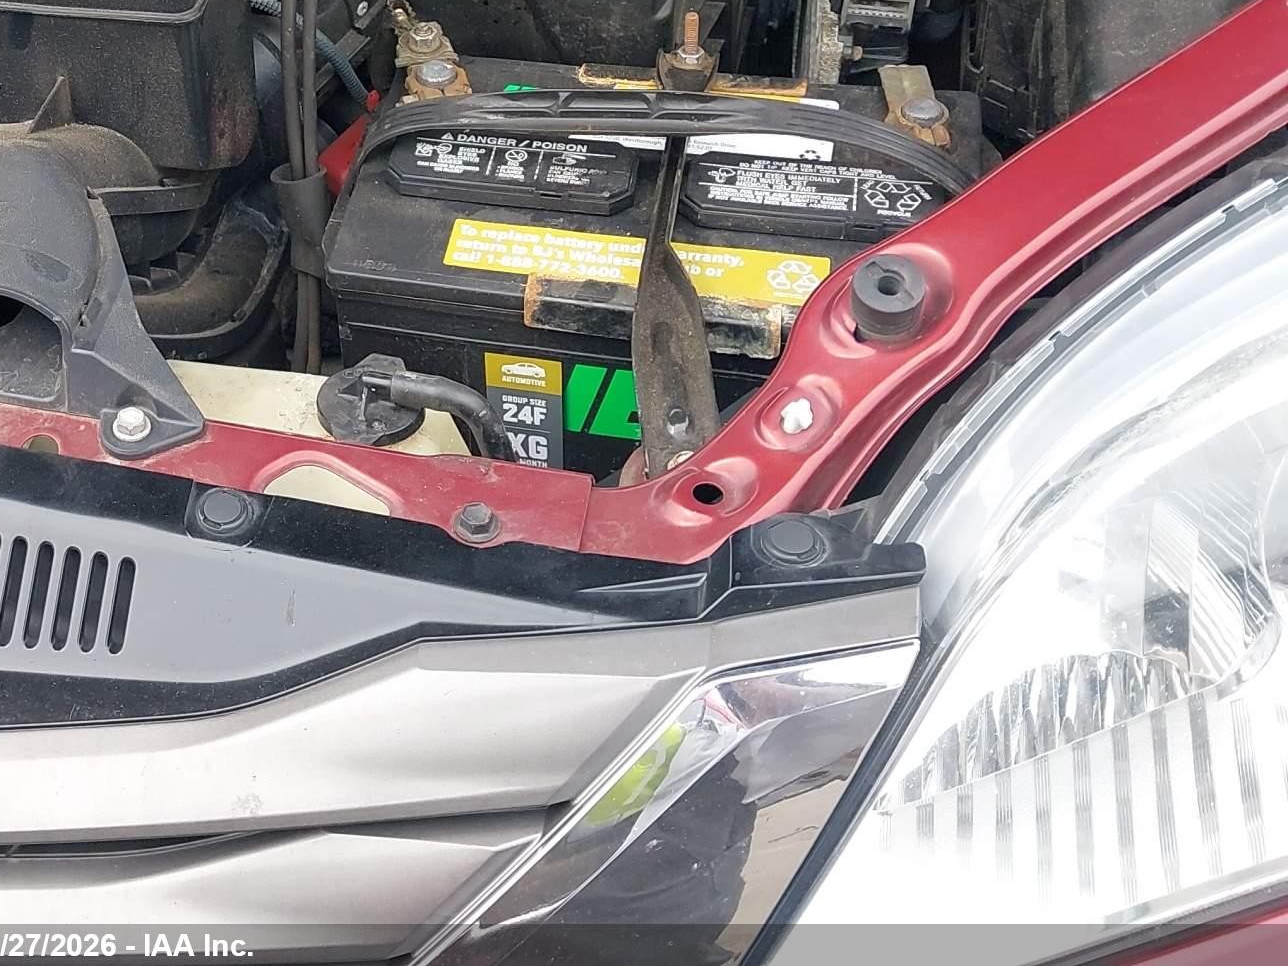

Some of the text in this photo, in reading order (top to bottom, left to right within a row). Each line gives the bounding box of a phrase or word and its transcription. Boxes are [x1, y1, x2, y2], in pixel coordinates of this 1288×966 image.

[457, 134, 517, 147] DANGER
[532, 140, 588, 153] POISON
[737, 169, 842, 184] FLUSH EYES IMMEDIATELY
[773, 183, 794, 191] HELP
[795, 185, 816, 193] FAST
[460, 224, 744, 268] To replace battery und arranty,
[452, 249, 481, 263] call
[456, 239, 507, 253] return
[511, 243, 529, 256] to
[532, 245, 566, 260] BJ's
[569, 248, 642, 267] Wholesa
[705, 266, 725, 277] or
[502, 375, 546, 387] AUTOMOTIVE
[502, 394, 547, 407] GROUP SIZE
[502, 403, 547, 426] 24F
[519, 458, 548, 469] MONTH
